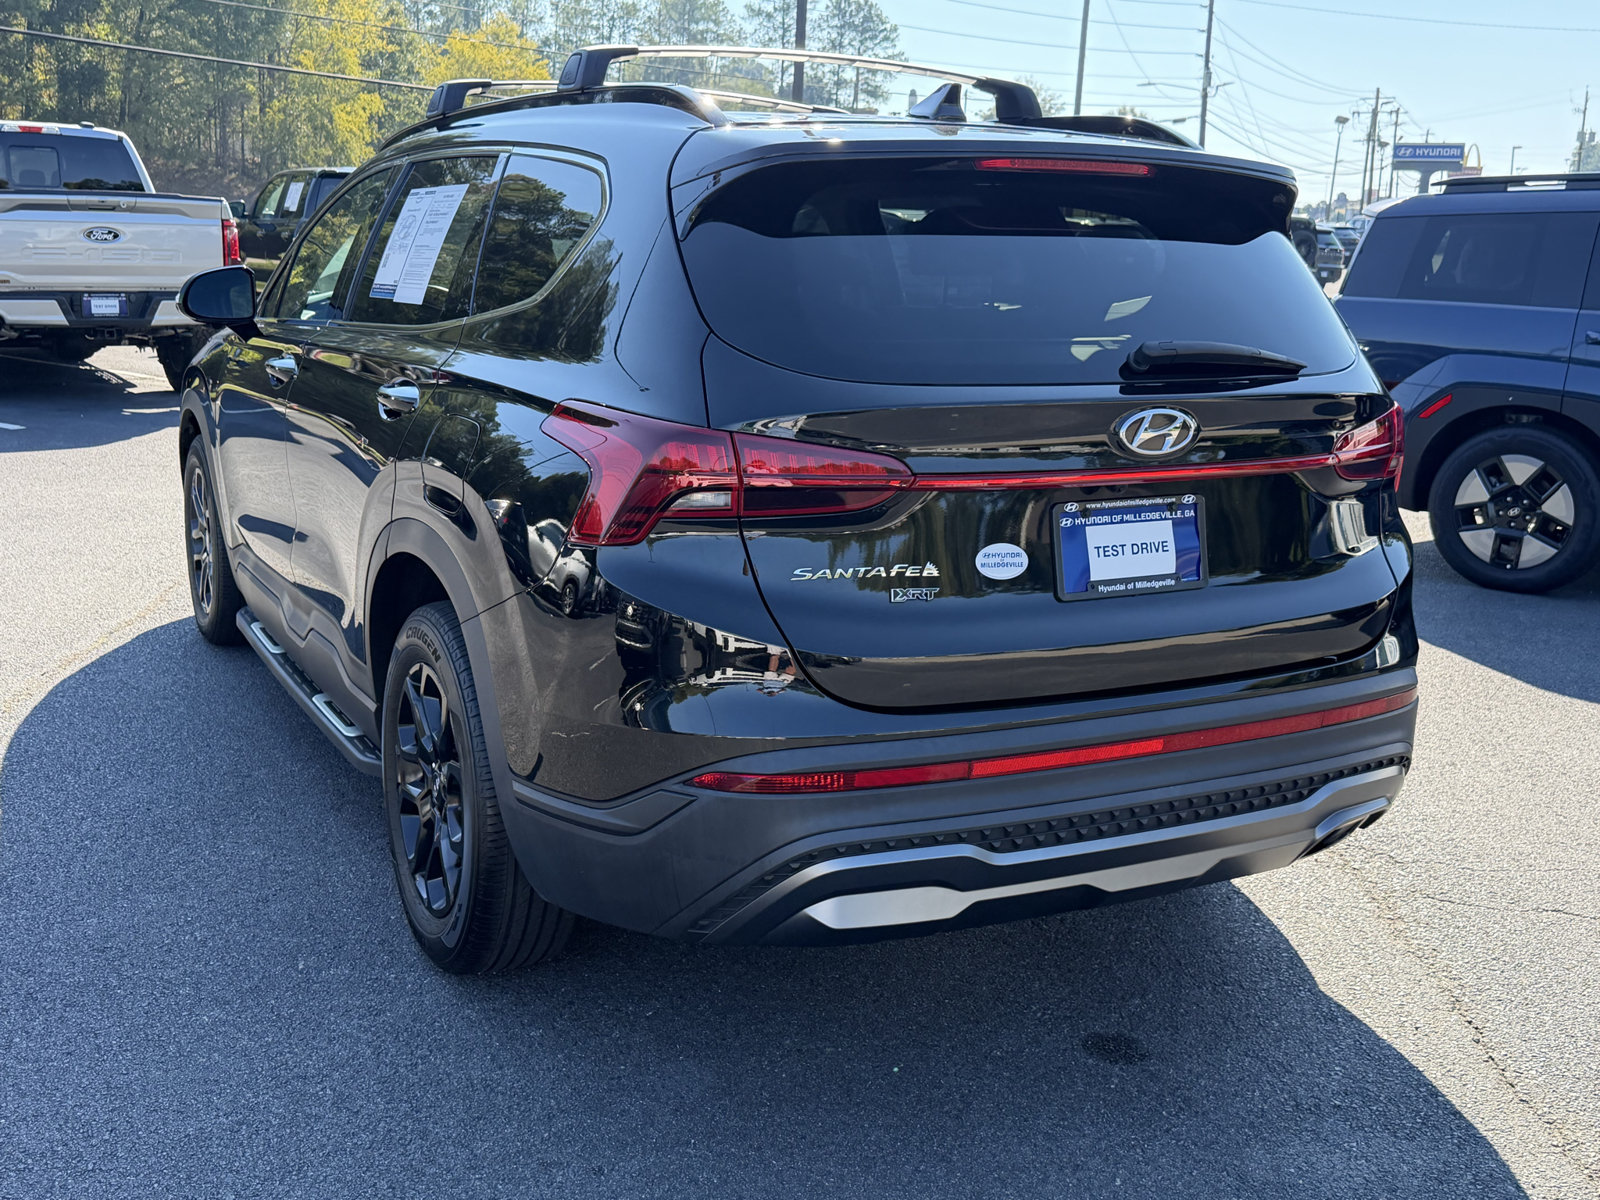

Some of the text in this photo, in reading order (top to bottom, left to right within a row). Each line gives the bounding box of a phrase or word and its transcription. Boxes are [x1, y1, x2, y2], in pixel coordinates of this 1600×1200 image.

[1416, 147, 1461, 156] HYUNDAI
[90, 230, 114, 241] Ford
[1074, 515, 1111, 525] HYUNDAI
[1112, 514, 1123, 522] OF
[1184, 509, 1195, 517] GA
[1094, 540, 1169, 558] TEST DRIVE
[1098, 583, 1126, 593] Hyundai
[1135, 579, 1176, 589] Milledgeville
[405, 626, 441, 663] CRUGEN
